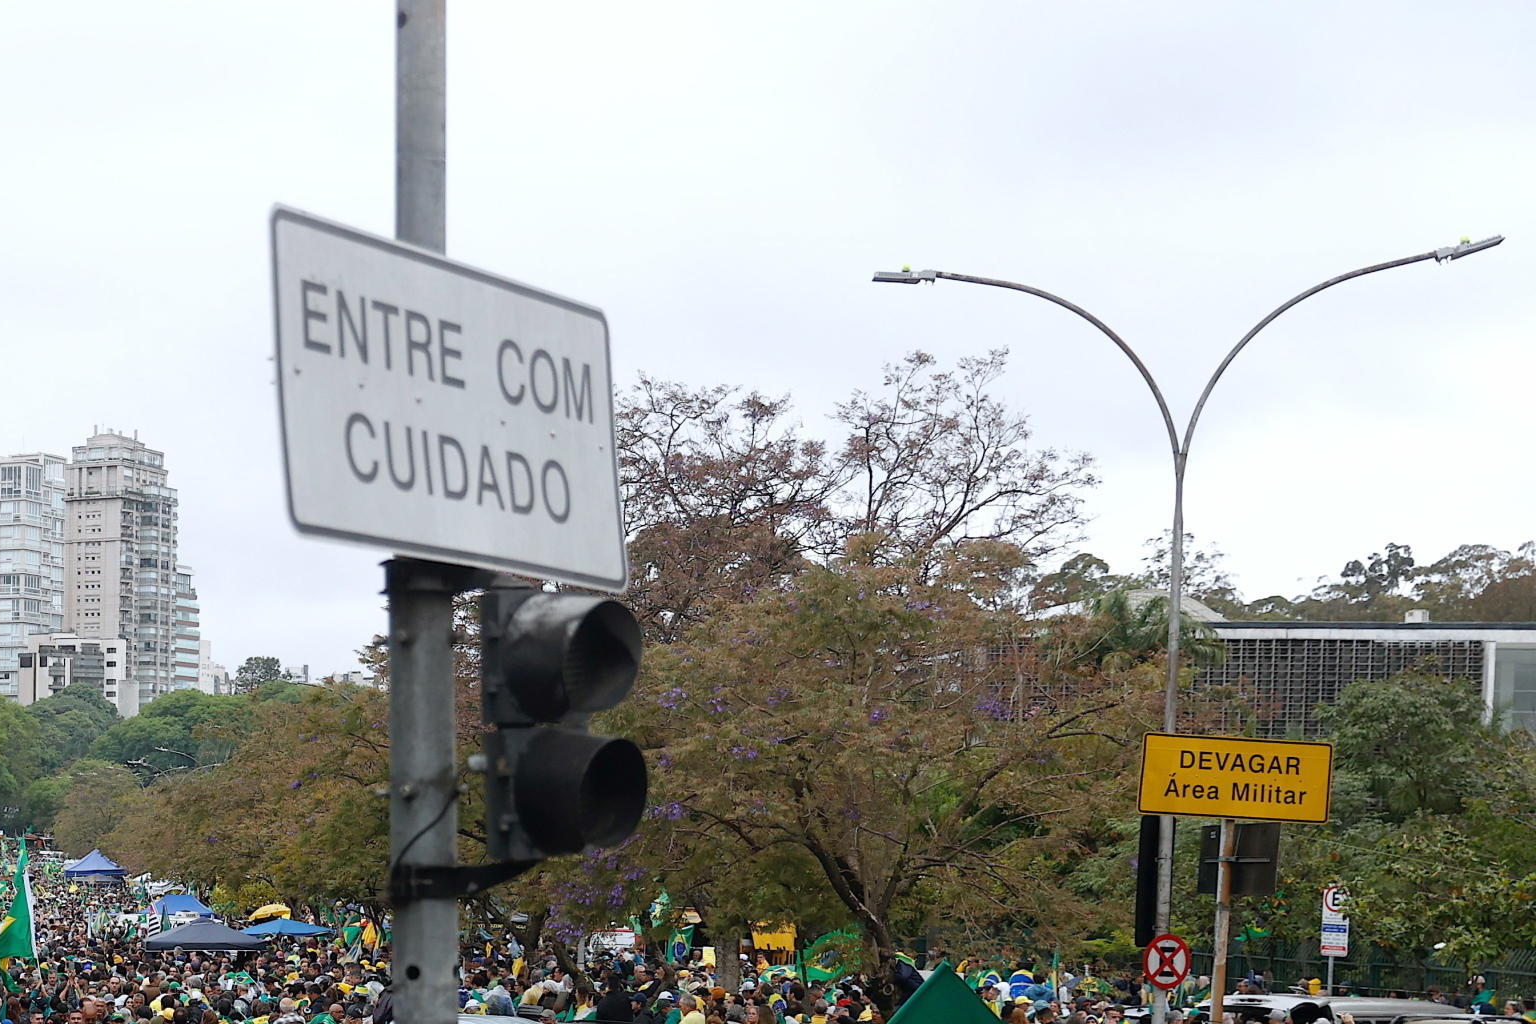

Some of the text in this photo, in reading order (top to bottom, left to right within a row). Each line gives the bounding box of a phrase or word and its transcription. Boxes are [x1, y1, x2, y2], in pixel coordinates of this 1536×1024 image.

[300, 279, 595, 425] ENTRE COM
[344, 412, 571, 524] CUIDADO
[1164, 773, 1307, 806] Área Militar
[1179, 750, 1301, 776] DEVAGAR
